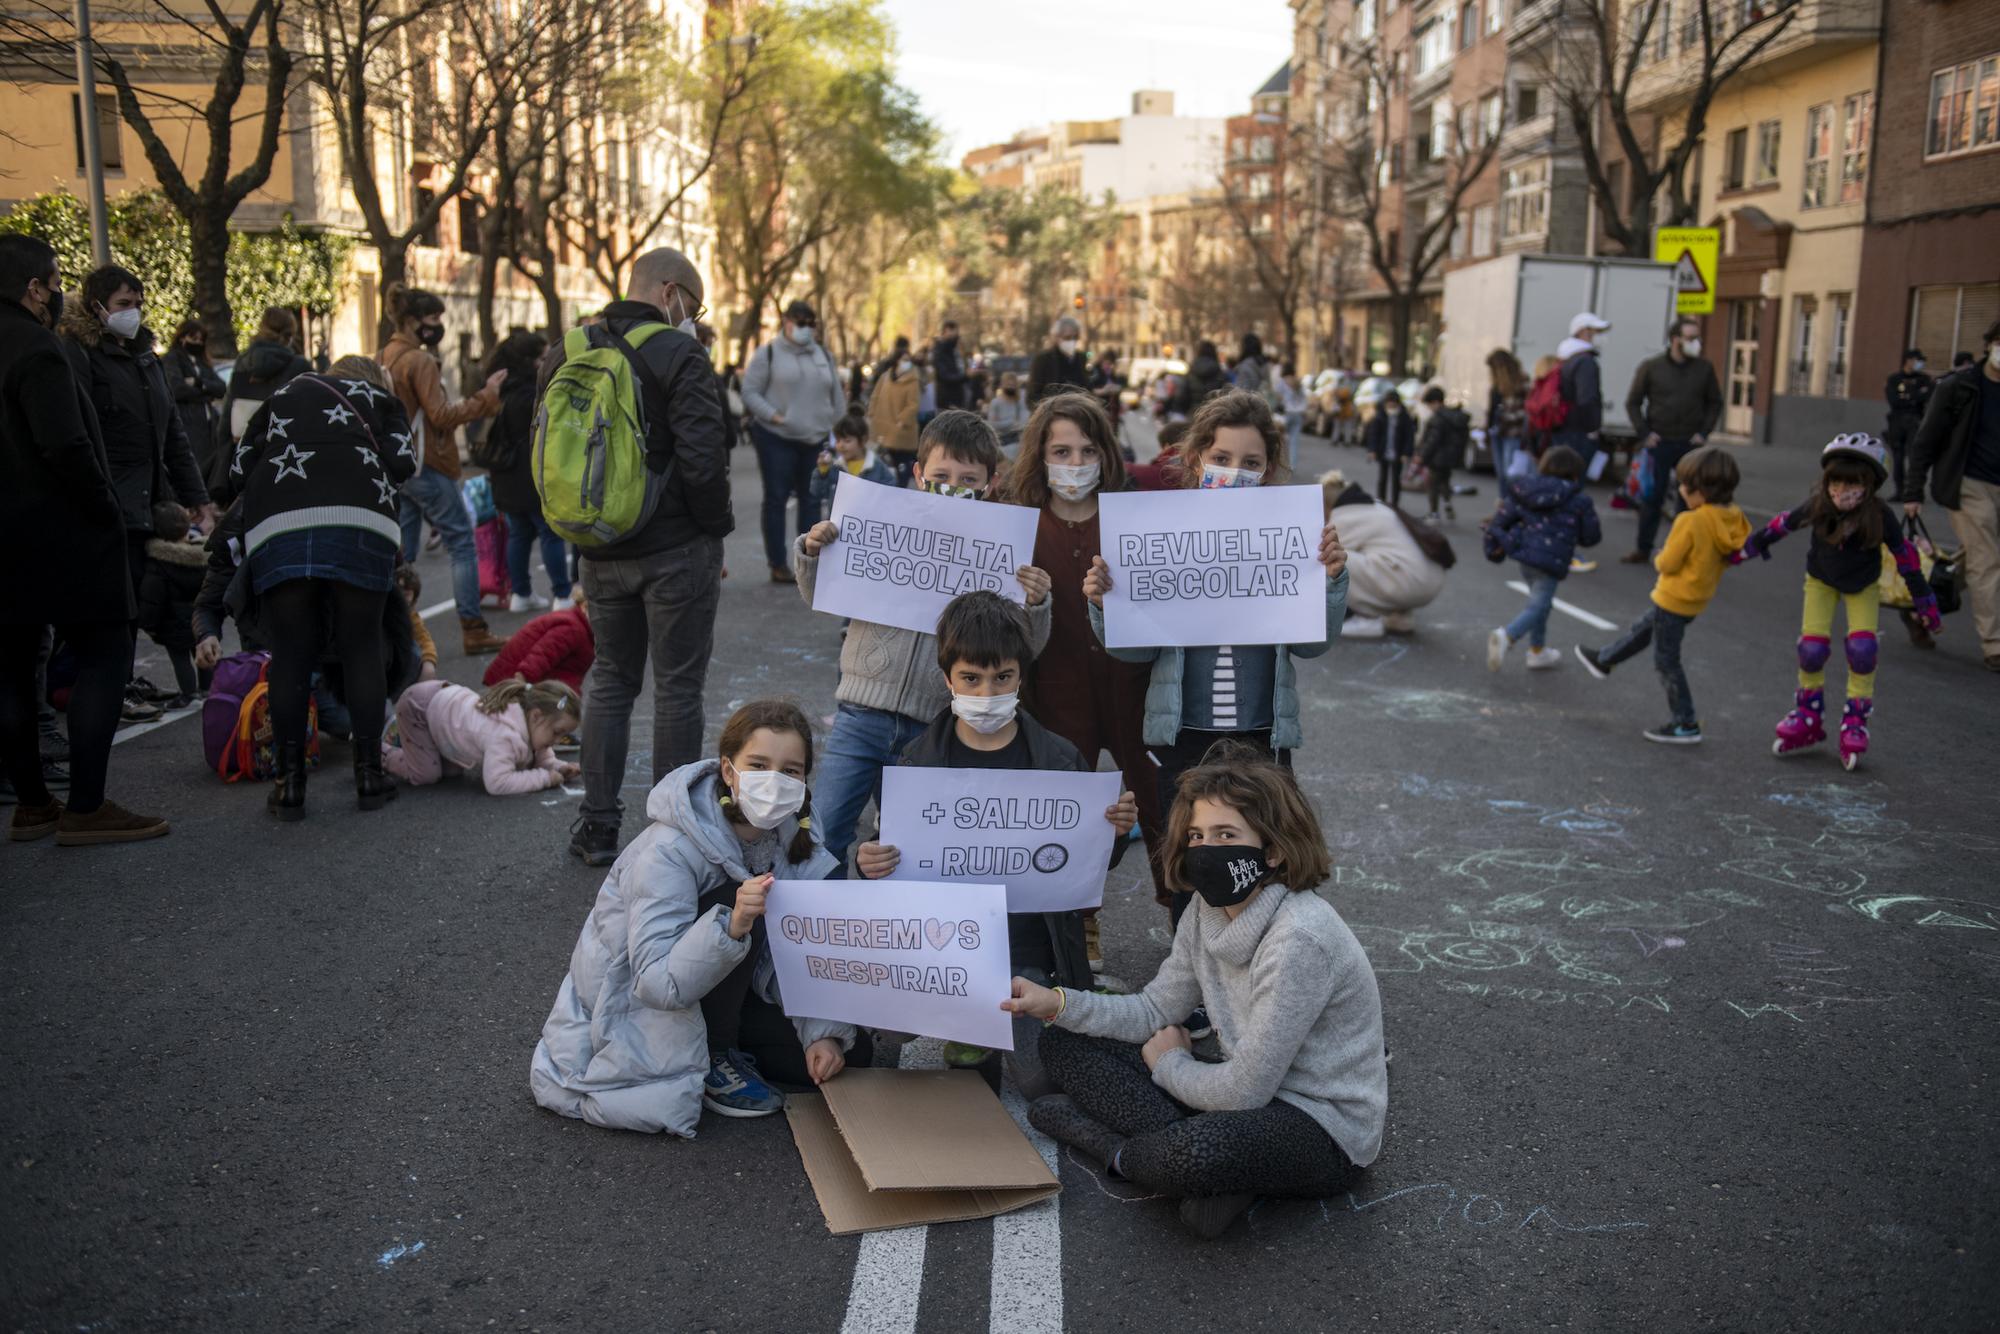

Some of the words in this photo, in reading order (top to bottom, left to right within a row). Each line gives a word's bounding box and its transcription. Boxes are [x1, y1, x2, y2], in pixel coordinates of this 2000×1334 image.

[839, 514, 1015, 575] REVUELTA
[1119, 526, 1309, 567] REVUELTA
[844, 546, 1003, 596] ESCOLAR
[1129, 563, 1299, 601] ESCOLAR
[953, 796, 1081, 831] SALUD
[1227, 859, 1258, 877] BEATLES
[805, 955, 968, 997] RESPIRAR
